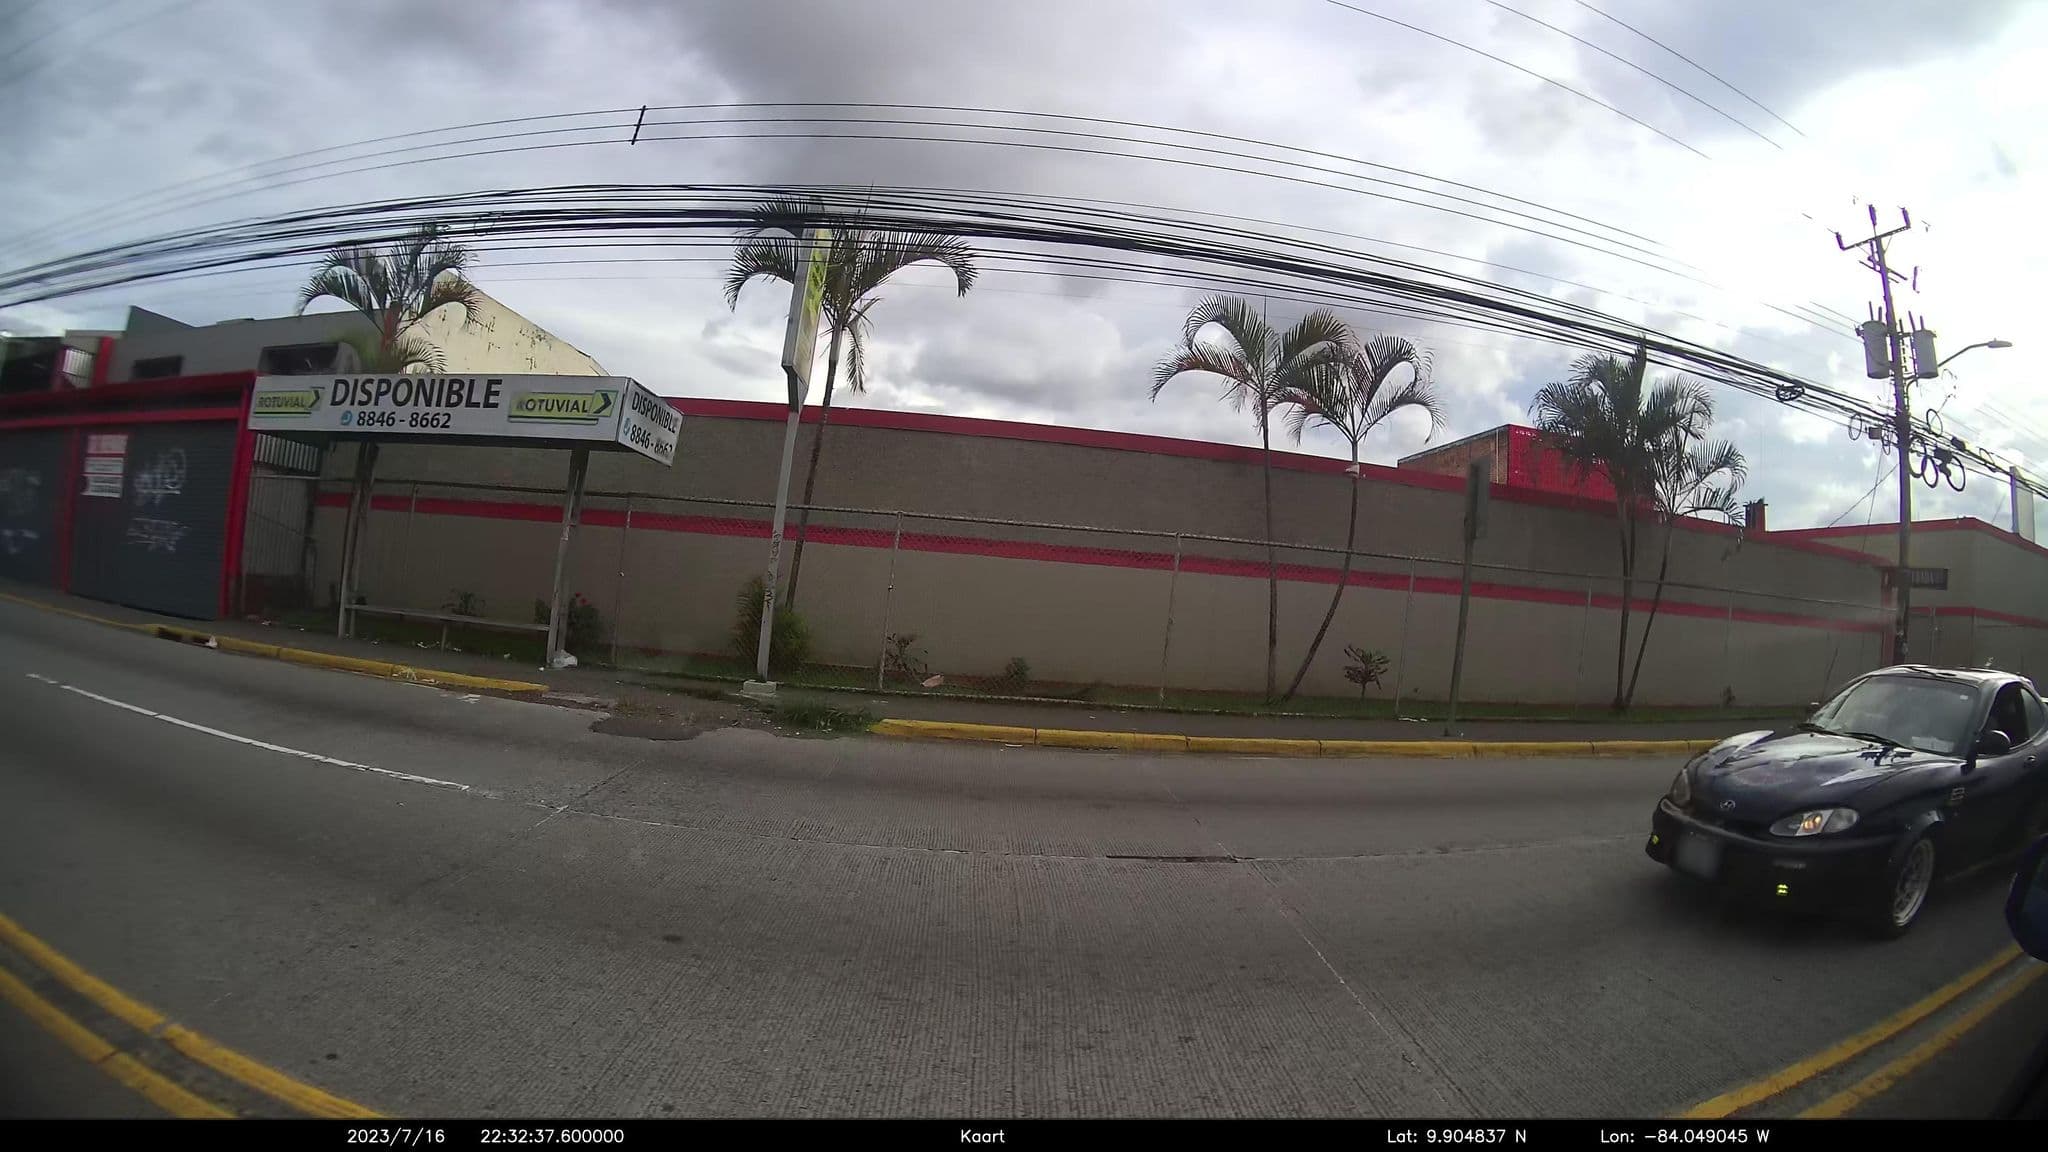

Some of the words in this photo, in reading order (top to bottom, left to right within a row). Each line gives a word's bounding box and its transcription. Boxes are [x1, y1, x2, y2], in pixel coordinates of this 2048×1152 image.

[330, 378, 503, 409] DISPONIBLE
[356, 410, 396, 428] 8846
[409, 411, 451, 429] 8662
[630, 424, 651, 450] 8846
